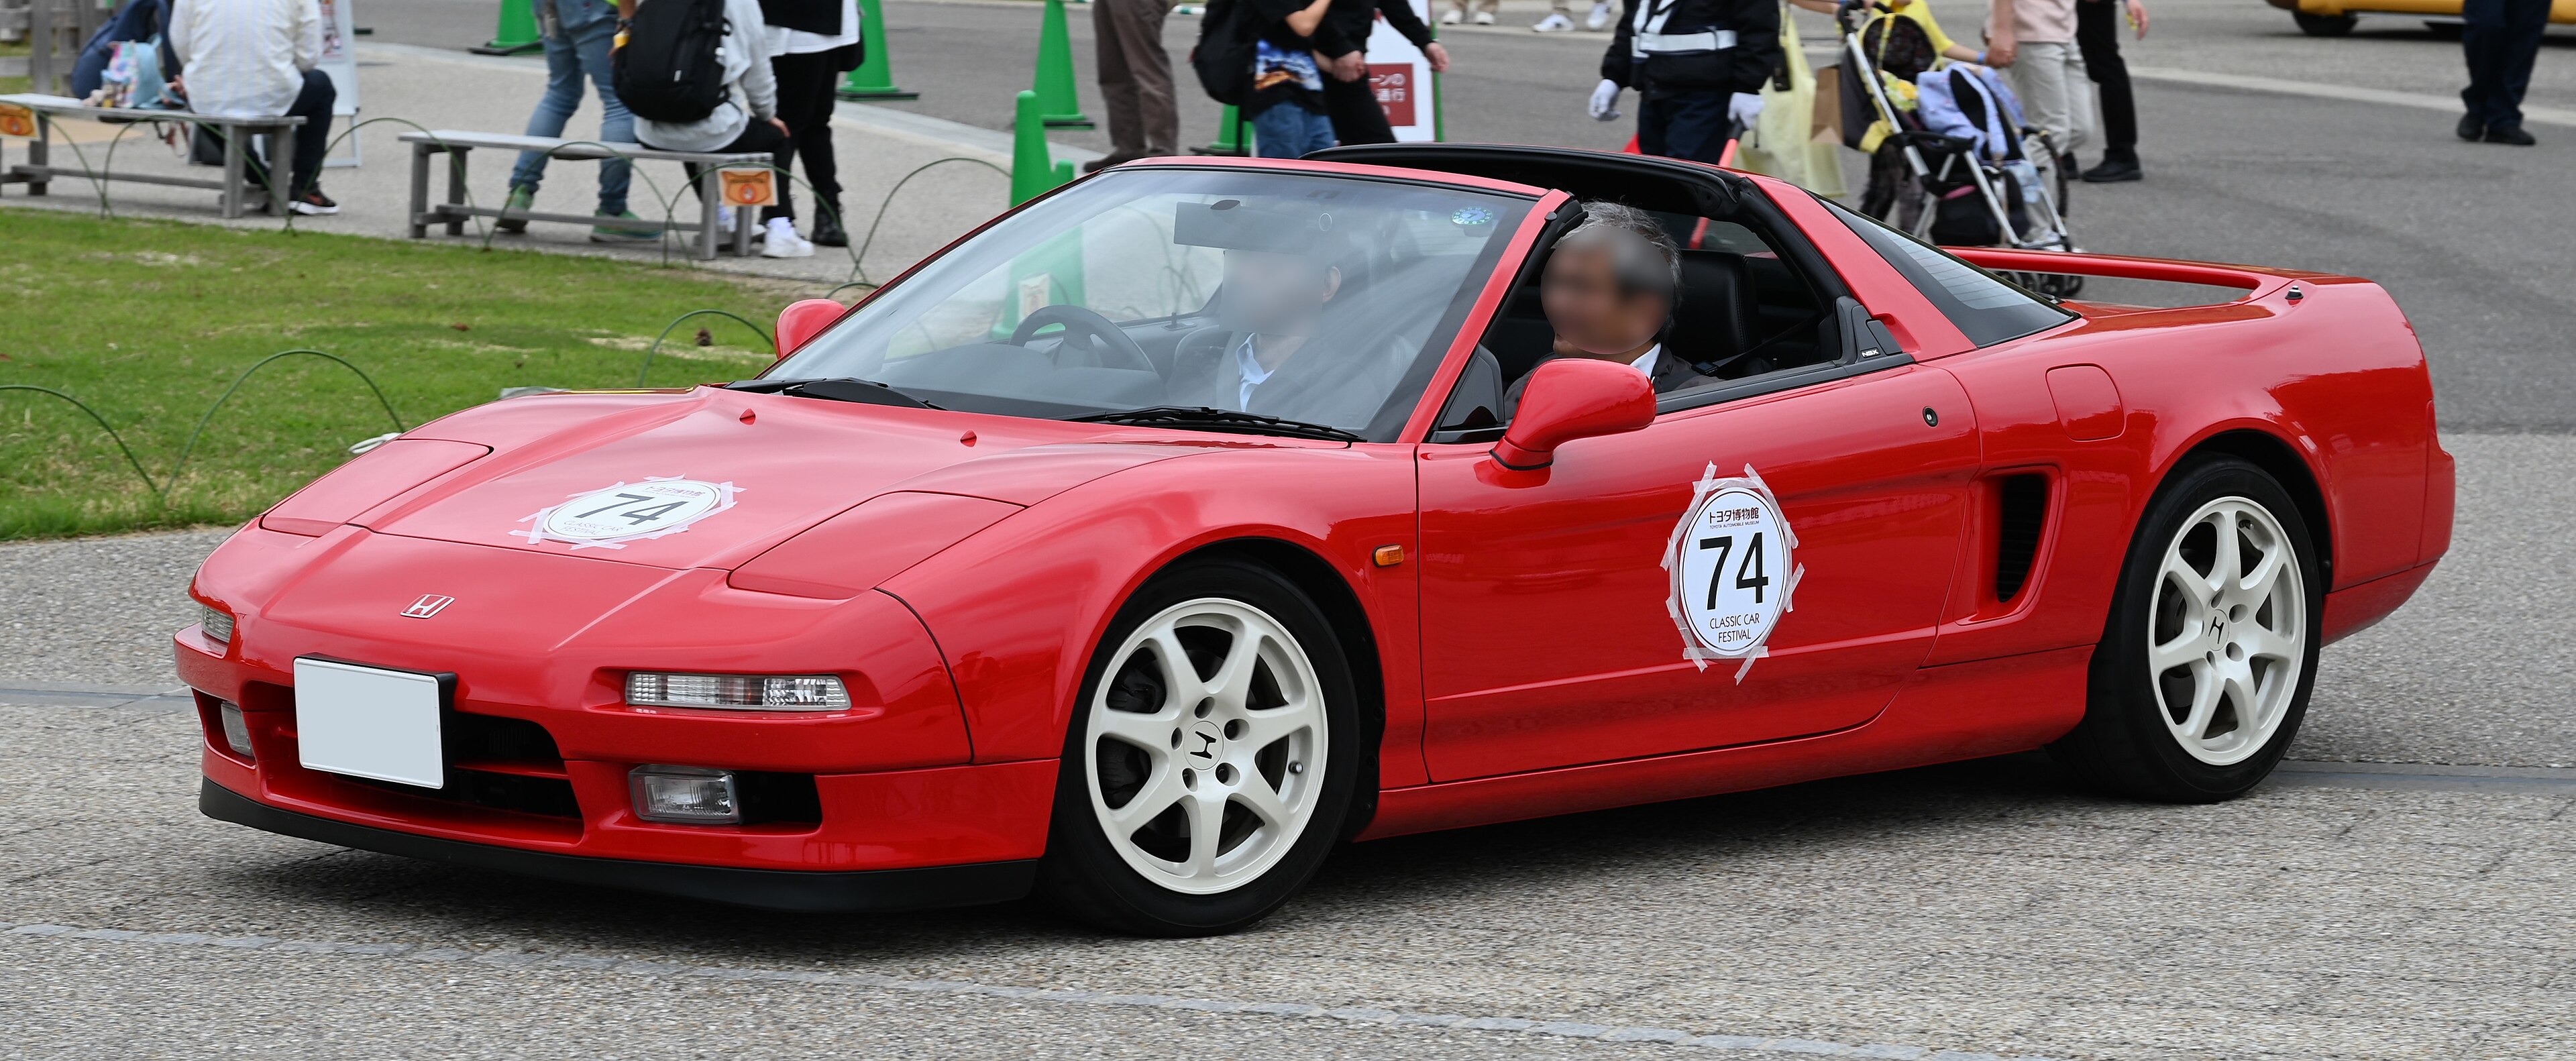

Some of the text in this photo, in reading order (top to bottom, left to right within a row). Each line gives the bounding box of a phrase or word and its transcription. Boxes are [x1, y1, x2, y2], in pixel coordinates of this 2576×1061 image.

[1862, 349, 1879, 357] NSX
[574, 493, 690, 526] 74
[1709, 507, 1759, 524] トヨタ博物館
[1699, 532, 1769, 610] 74
[1709, 613, 1760, 629] CLASSIC CAR
[1718, 628, 1752, 643] FESTIVAL
